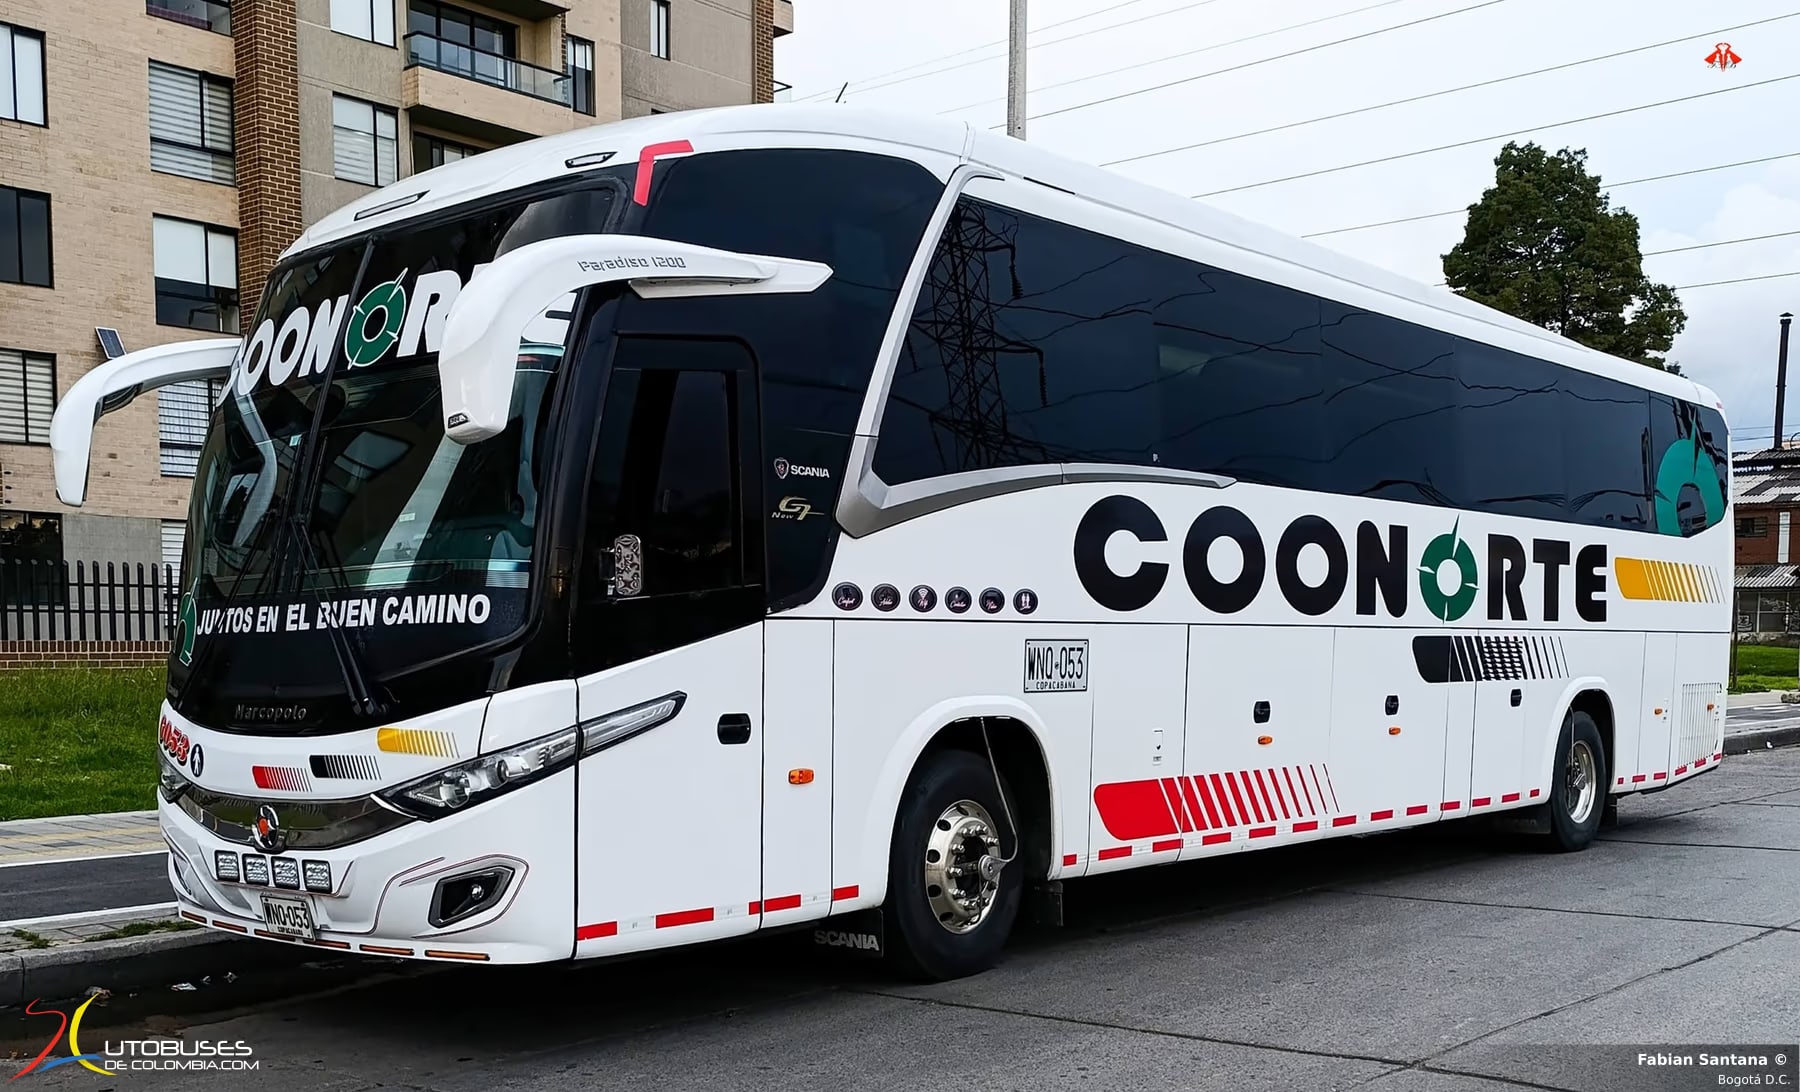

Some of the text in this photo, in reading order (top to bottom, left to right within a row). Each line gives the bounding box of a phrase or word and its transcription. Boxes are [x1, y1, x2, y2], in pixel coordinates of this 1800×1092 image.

[577, 256, 687, 272] Paradiso 1200
[790, 464, 830, 478] SCANIA
[771, 511, 794, 519] New
[1073, 494, 1608, 623] COONORTE
[197, 594, 491, 635] JUNTOS EN EL BUEN CAMINO
[1035, 681, 1076, 690] COPACABANA
[235, 703, 307, 722] Marcopolo
[814, 929, 880, 951] SCANIA
